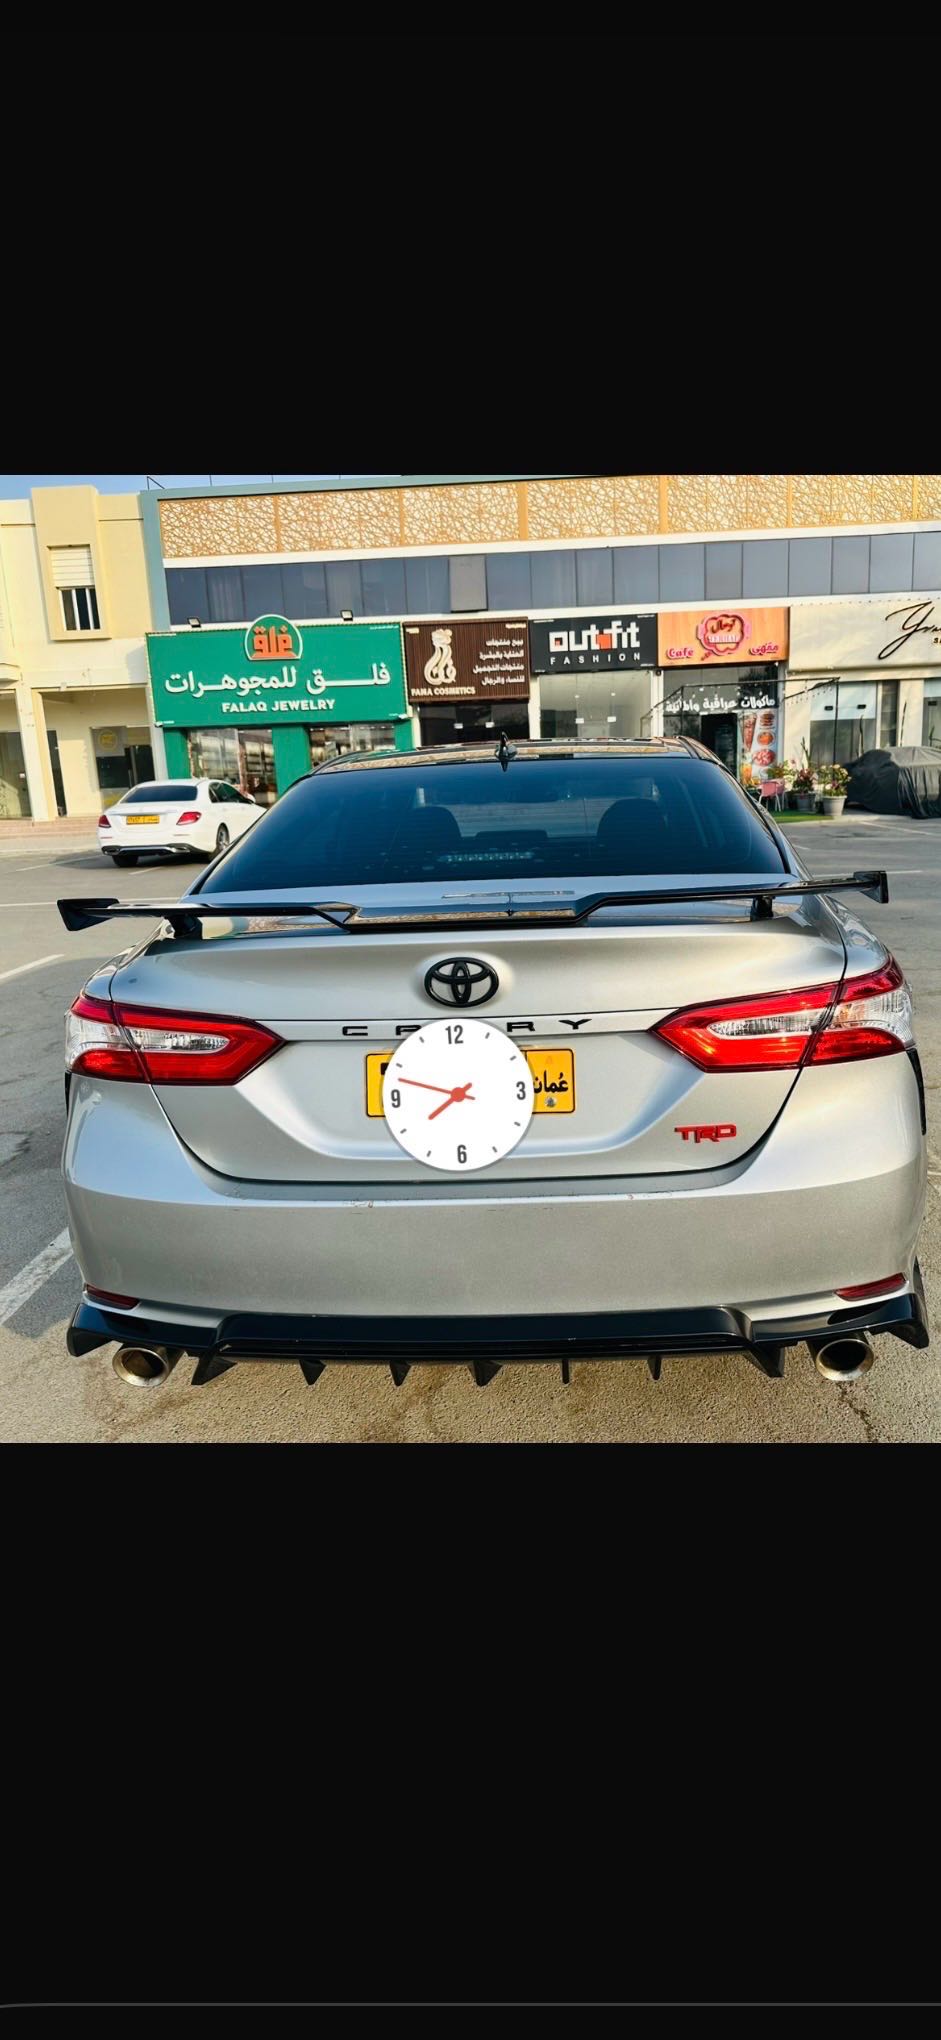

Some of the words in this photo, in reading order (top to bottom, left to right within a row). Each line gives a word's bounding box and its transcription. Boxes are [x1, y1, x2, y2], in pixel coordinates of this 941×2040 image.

[550, 652, 641, 665] FASHION
[165, 666, 297, 698] للمجوهرات
[433, 686, 476, 696] COSMETICS
[222, 701, 268, 713] FALAQ
[271, 699, 336, 712] JEWELRY
[342, 1018, 593, 1037] CARY
[674, 1124, 737, 1144] TRD
